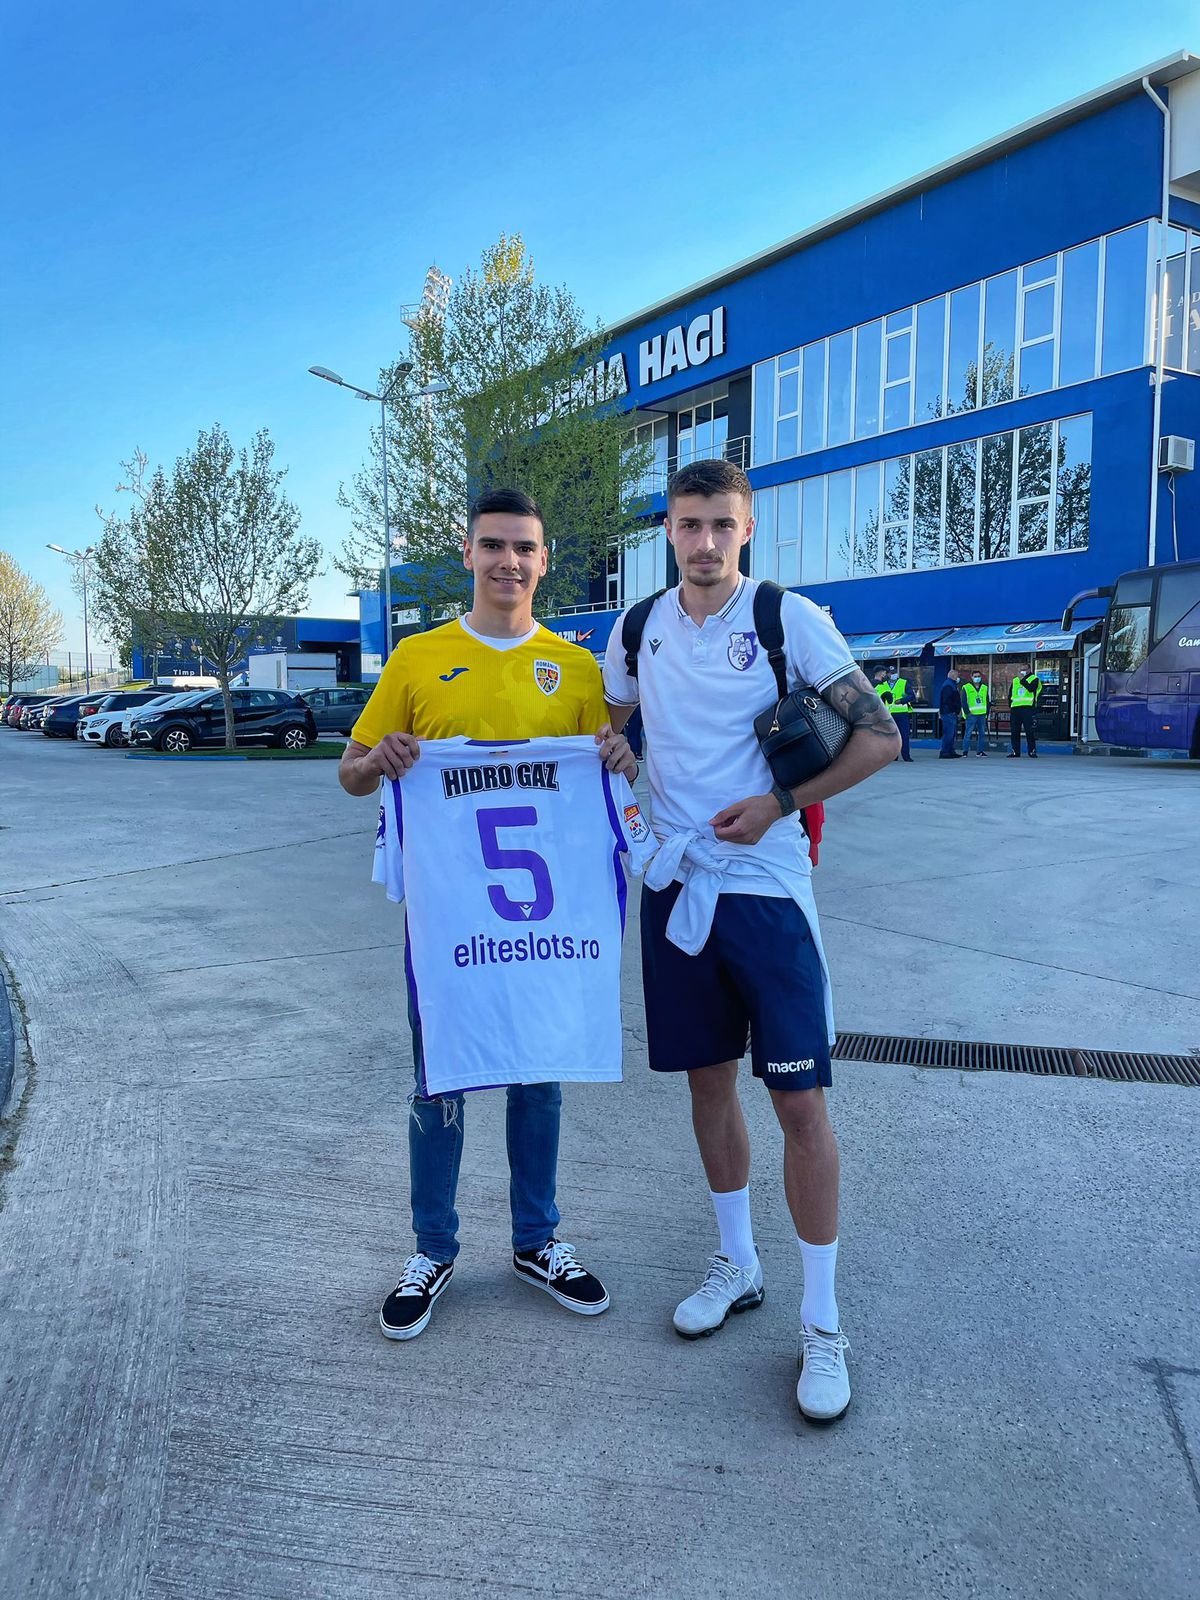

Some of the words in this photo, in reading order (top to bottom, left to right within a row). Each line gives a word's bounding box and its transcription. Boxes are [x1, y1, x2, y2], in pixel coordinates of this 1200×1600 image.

[639, 306, 724, 387] HAGI
[441, 763, 515, 799] HIDRO
[515, 761, 560, 791] GAZ
[476, 806, 554, 921] 5
[454, 932, 600, 968] eliteslots.ro
[767, 1058, 814, 1073] macron
